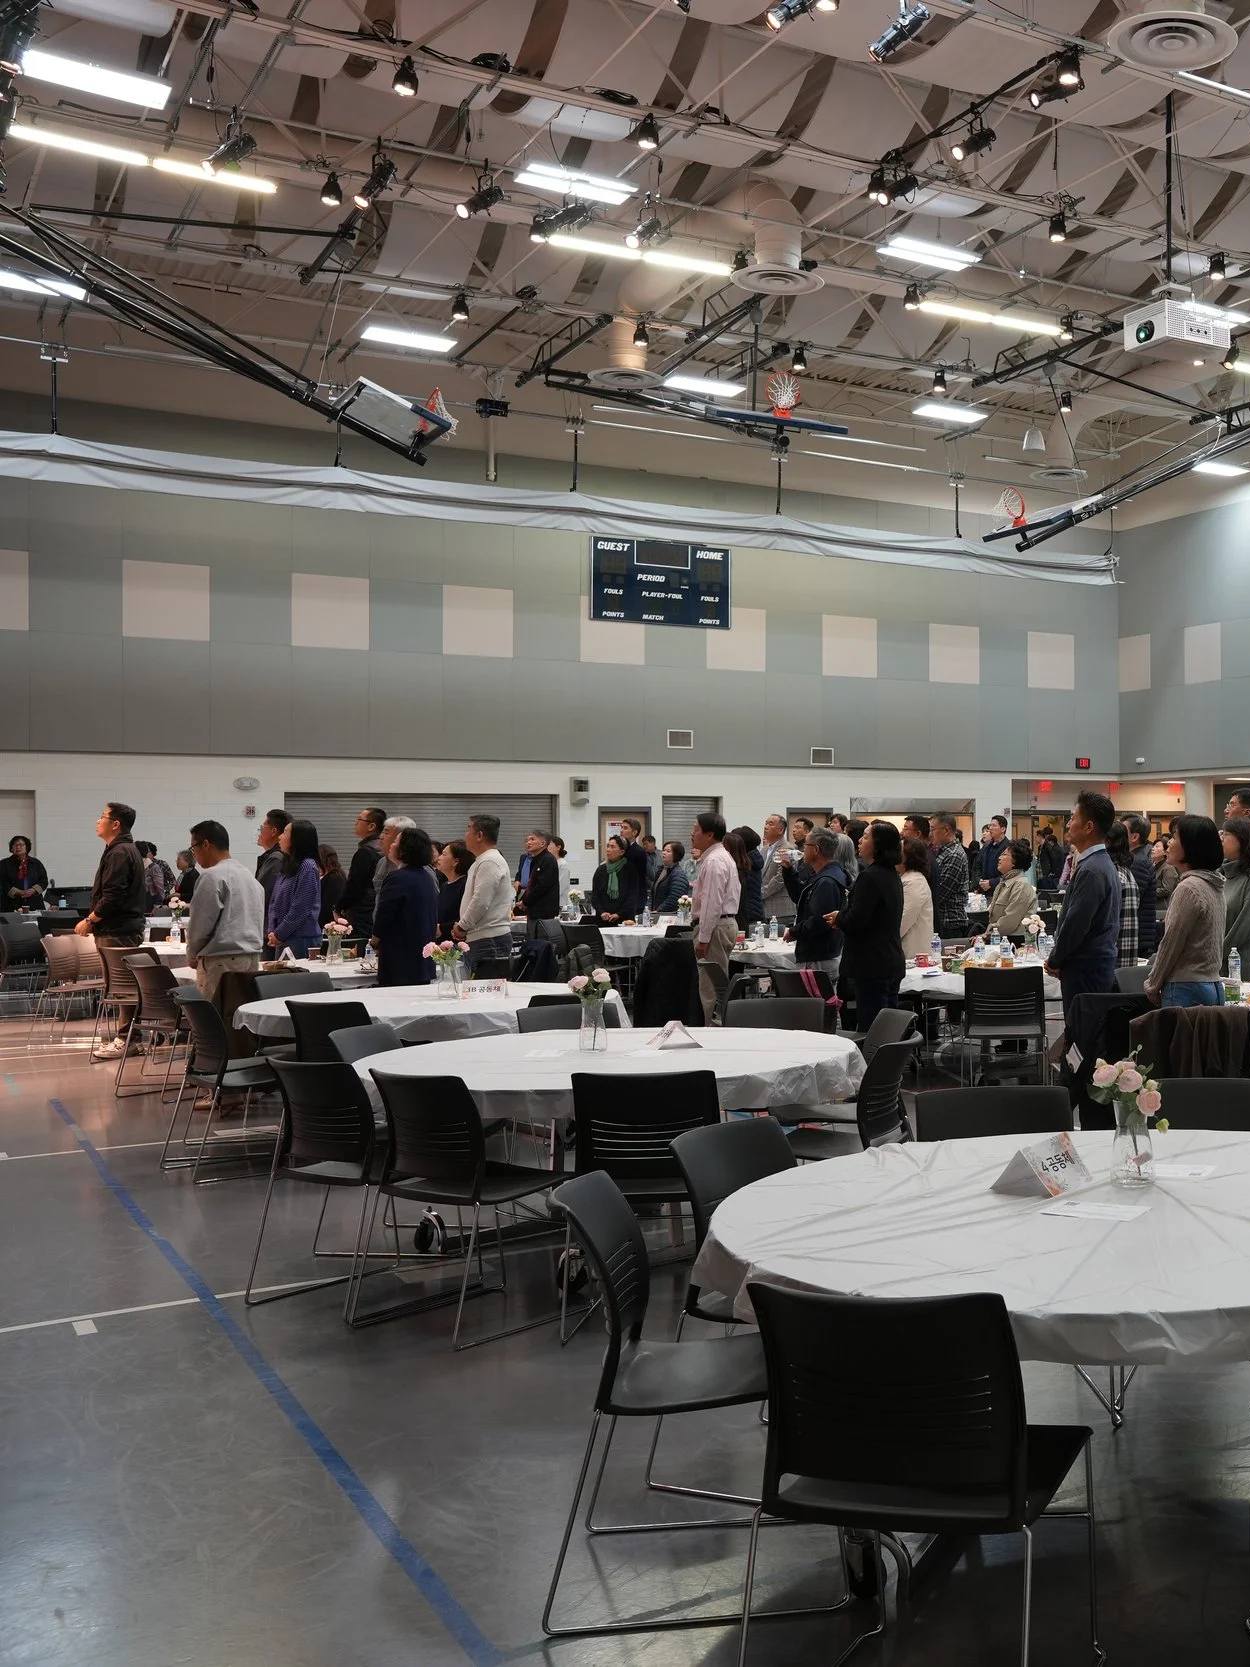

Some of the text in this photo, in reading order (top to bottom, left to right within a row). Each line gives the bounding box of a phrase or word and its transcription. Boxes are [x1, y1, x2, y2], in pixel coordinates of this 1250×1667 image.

[597, 541, 630, 551] GUEST
[696, 550, 724, 561] HOME
[637, 573, 666, 582] PERIOD
[641, 591, 683, 600] PLAYER-FOUL
[700, 595, 720, 603] FOULS
[602, 610, 625, 618] POINTS
[1079, 758, 1089, 768] EXIT
[1046, 1150, 1075, 1171] 공동체
